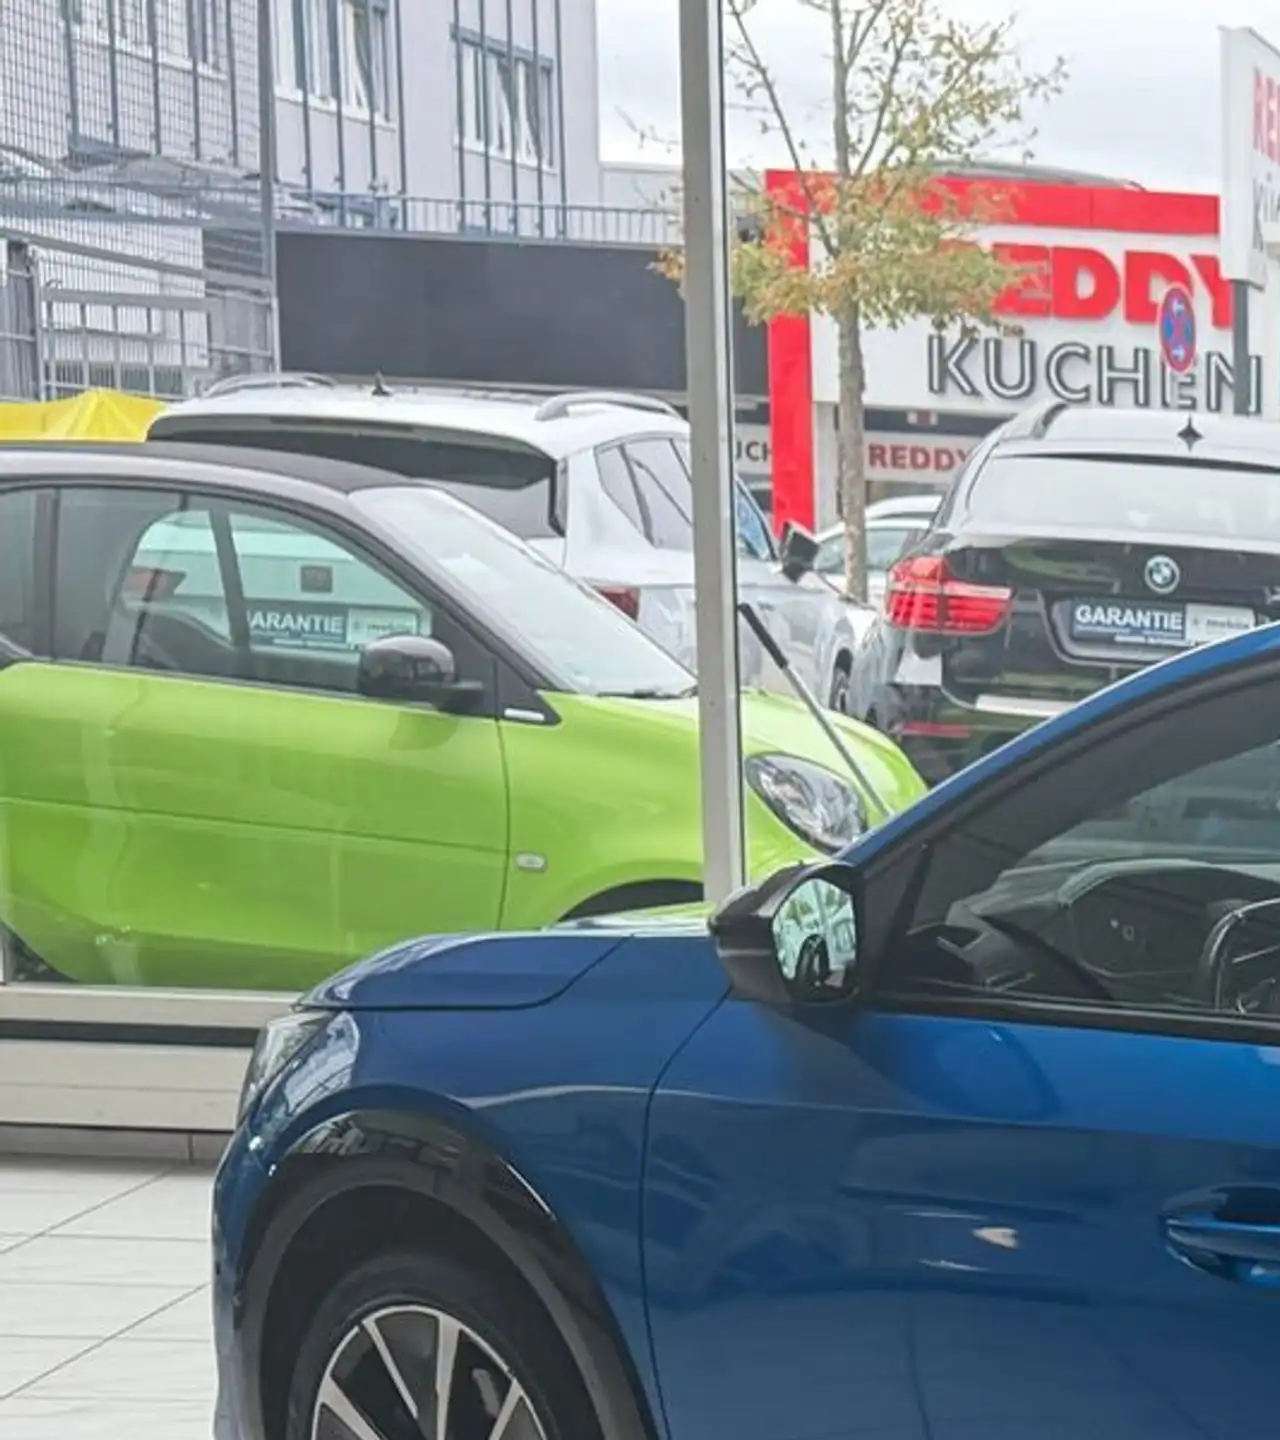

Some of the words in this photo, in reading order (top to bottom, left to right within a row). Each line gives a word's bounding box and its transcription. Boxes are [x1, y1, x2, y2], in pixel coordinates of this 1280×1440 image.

[988, 242, 1234, 330] EDDY
[247, 610, 345, 633] ARANTIE
[1075, 605, 1184, 630] GARANTIE
